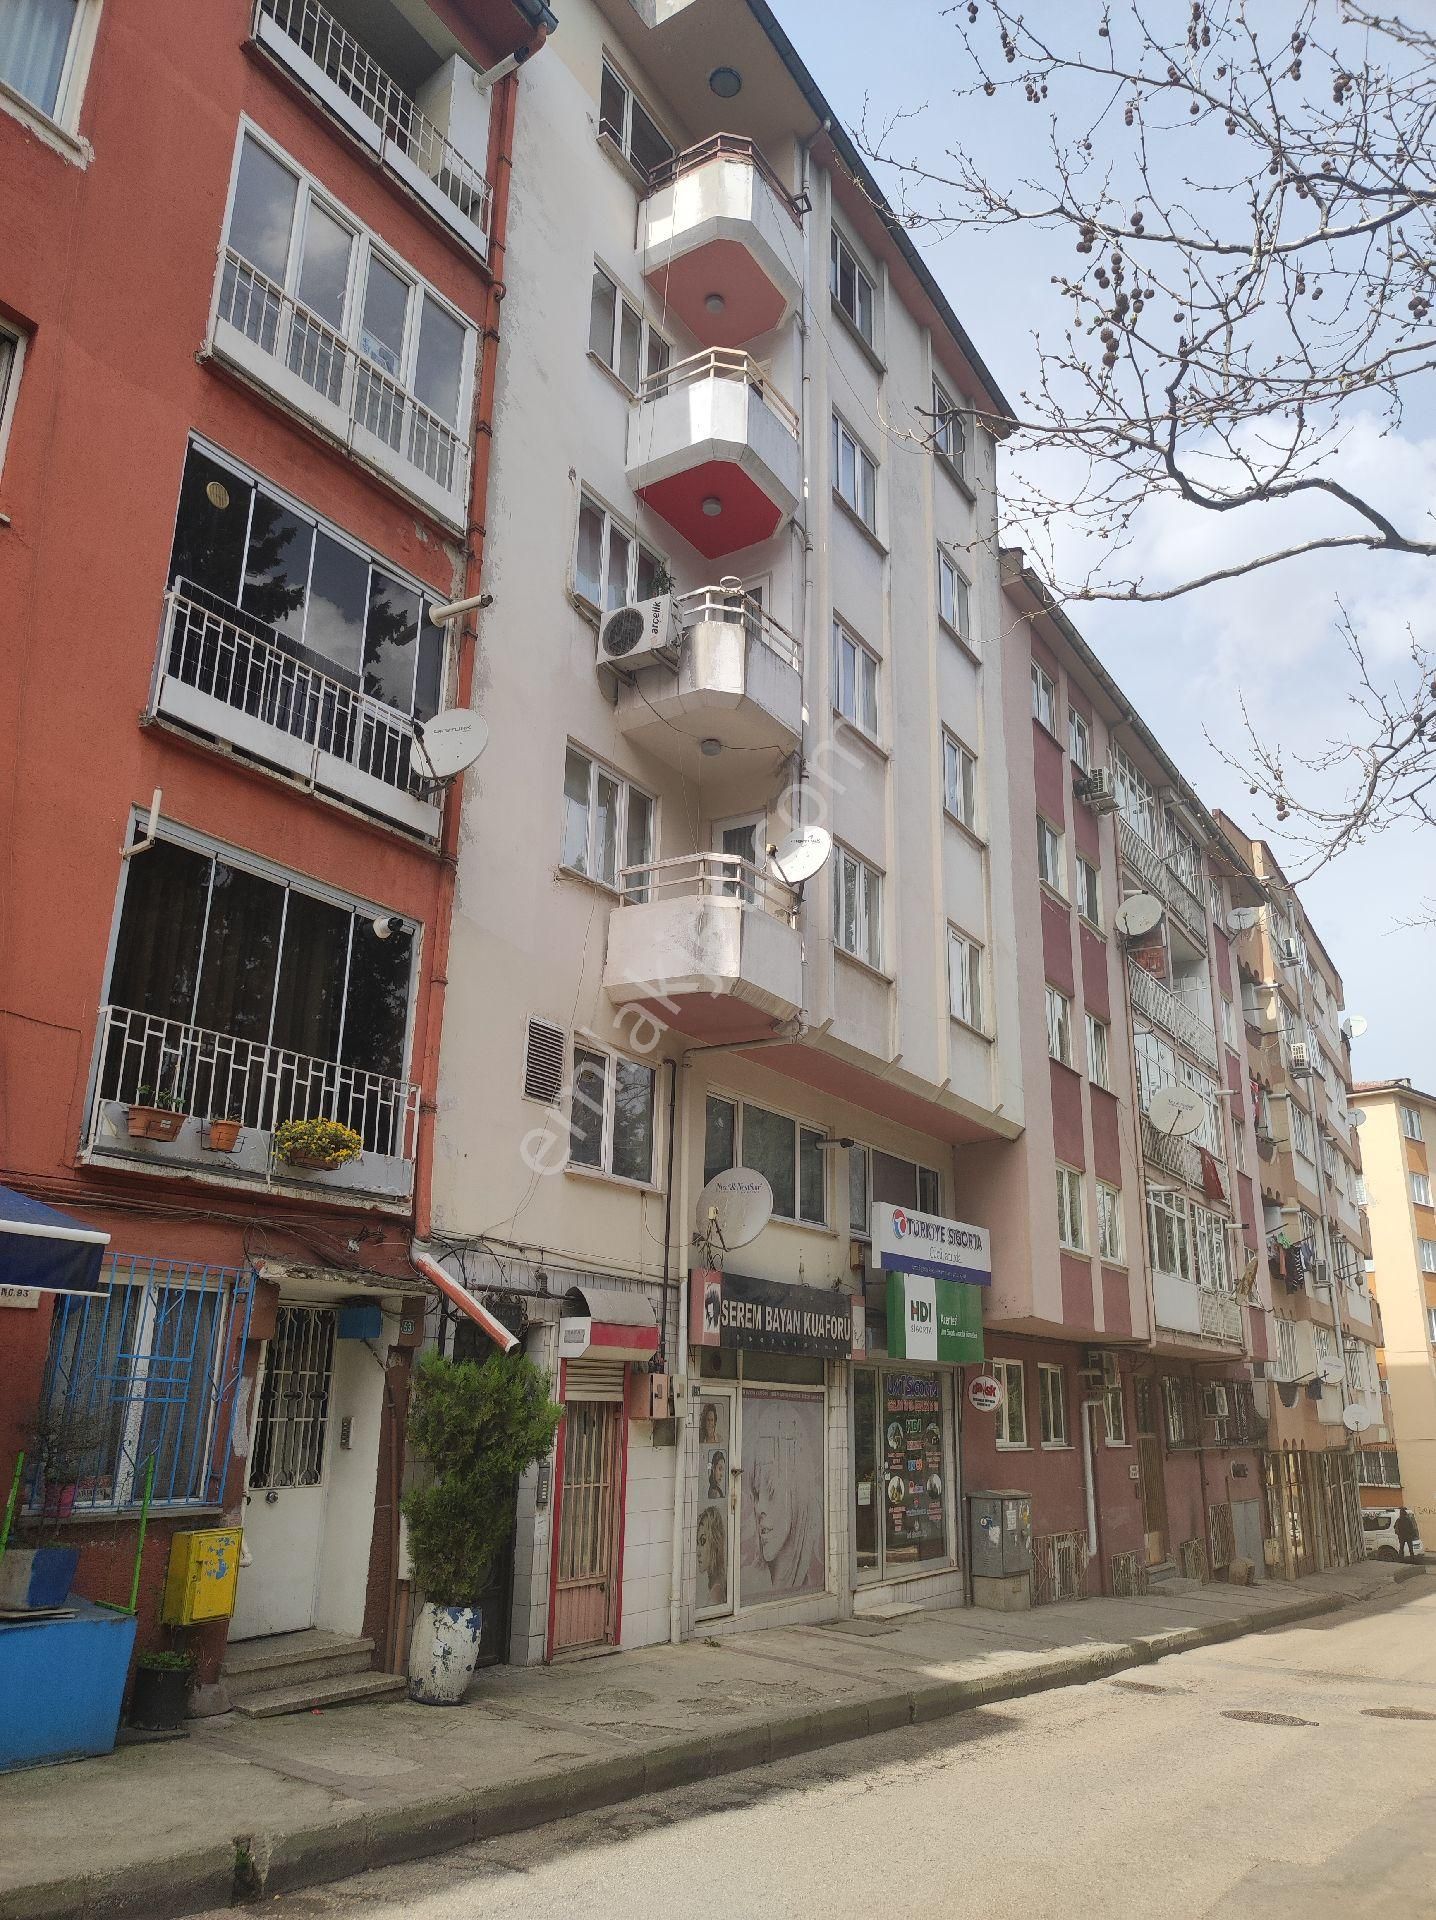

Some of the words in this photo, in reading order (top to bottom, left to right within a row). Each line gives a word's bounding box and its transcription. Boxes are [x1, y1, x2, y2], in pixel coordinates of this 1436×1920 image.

[721, 1300, 762, 1331] SEREM
[765, 1306, 800, 1335] BAYAN
[910, 1300, 932, 1323] HDI
